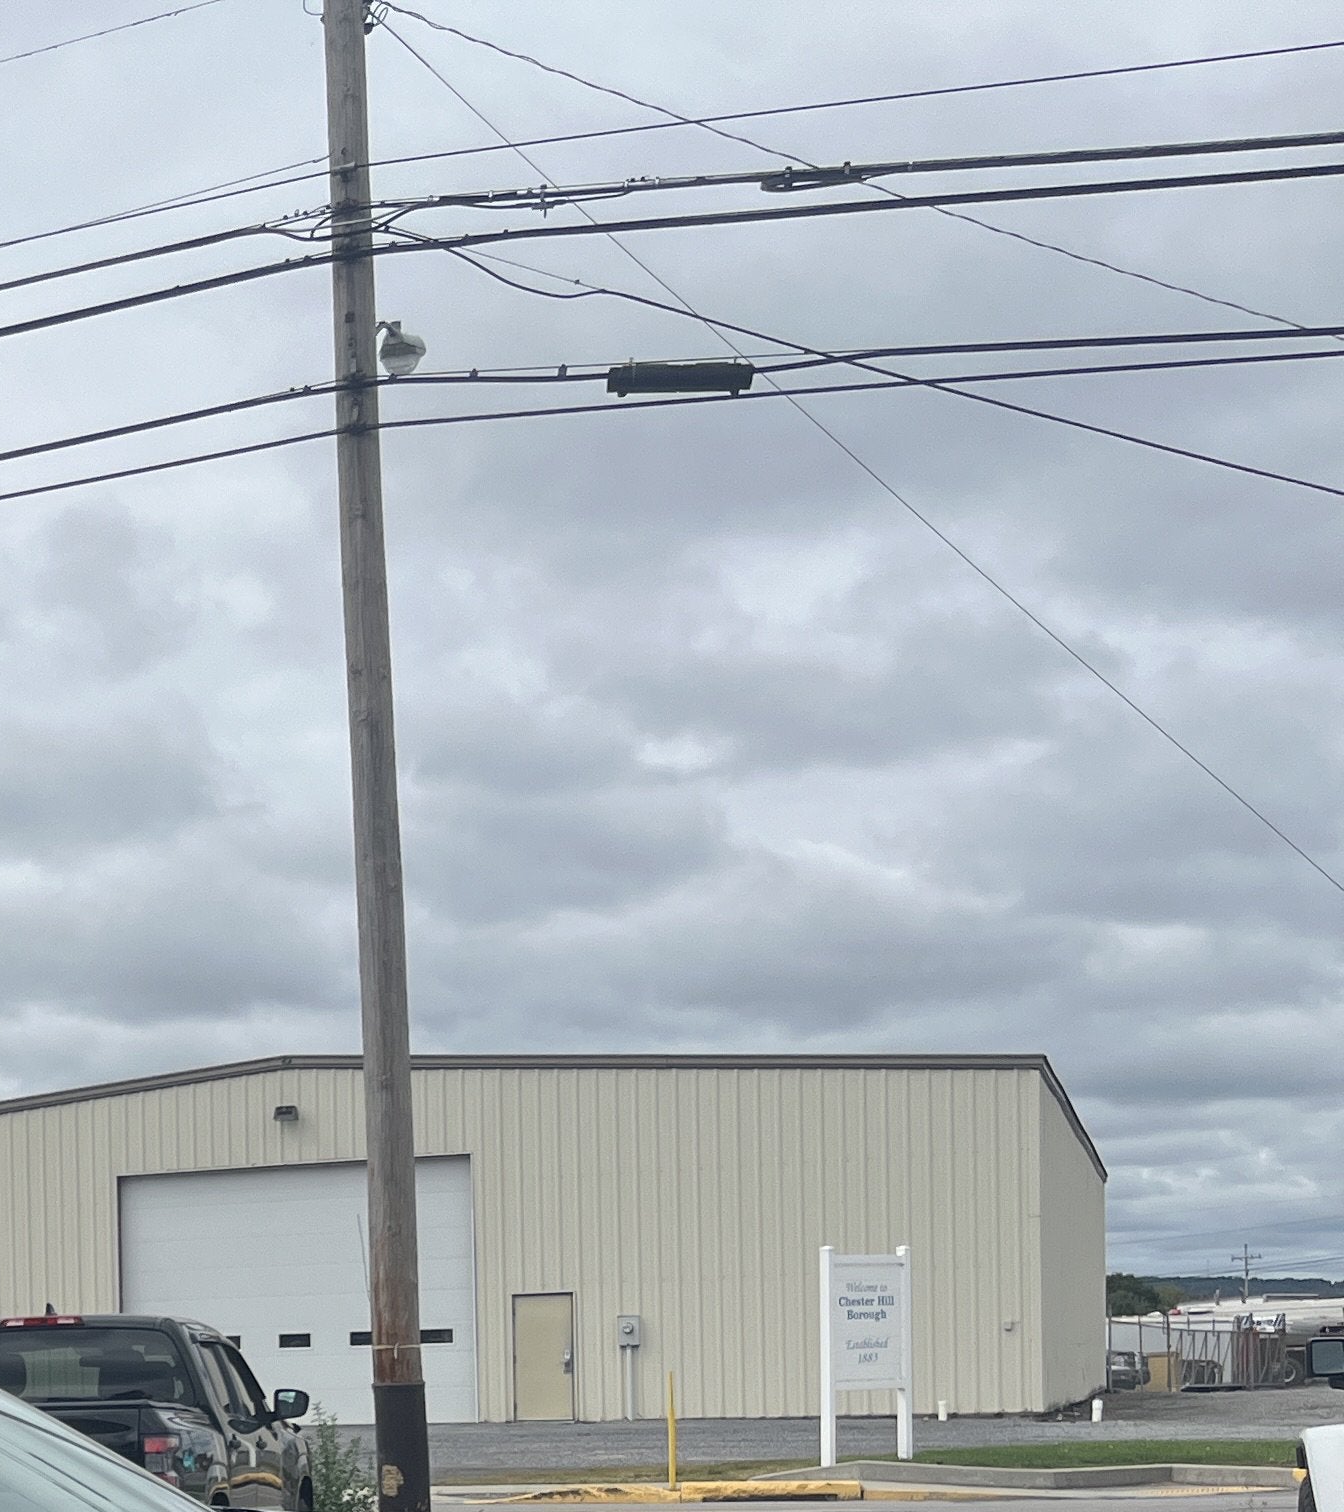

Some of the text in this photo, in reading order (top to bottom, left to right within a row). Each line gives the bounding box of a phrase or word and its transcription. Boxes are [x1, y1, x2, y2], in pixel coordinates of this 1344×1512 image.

[846, 1282, 887, 1293] Welcome to
[839, 1295, 895, 1307] Chester Hill
[847, 1309, 887, 1322] Borough
